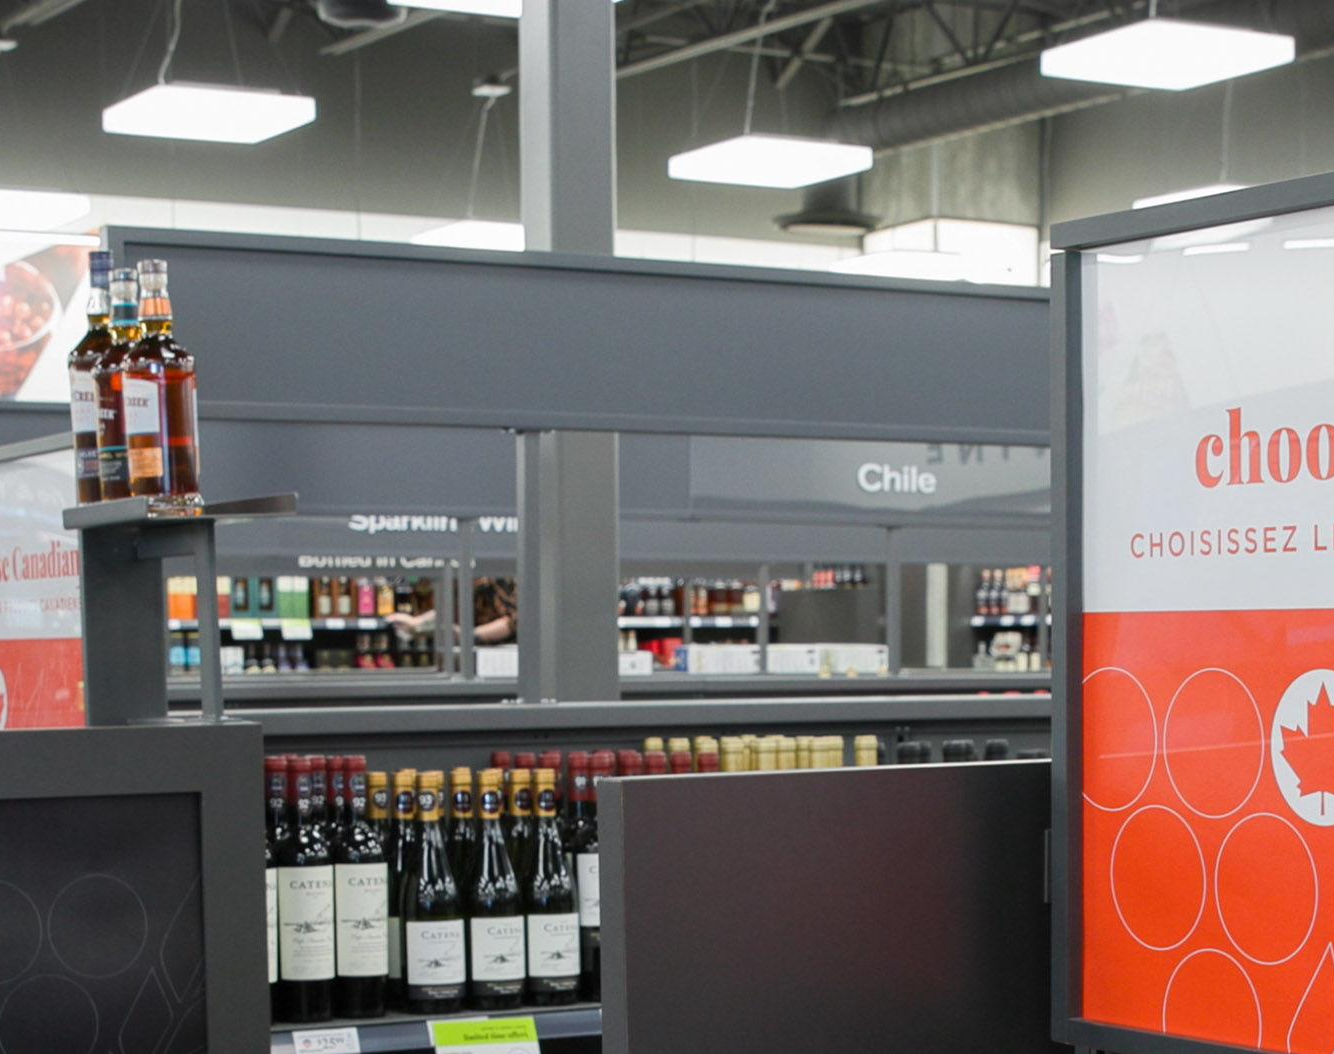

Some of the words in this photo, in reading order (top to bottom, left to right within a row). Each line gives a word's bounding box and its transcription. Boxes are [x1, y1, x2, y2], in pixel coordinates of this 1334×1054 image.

[857, 462, 937, 493] Chile
[1130, 525, 1298, 559] CHOISISSEZ
[12, 540, 81, 581] Canadian
